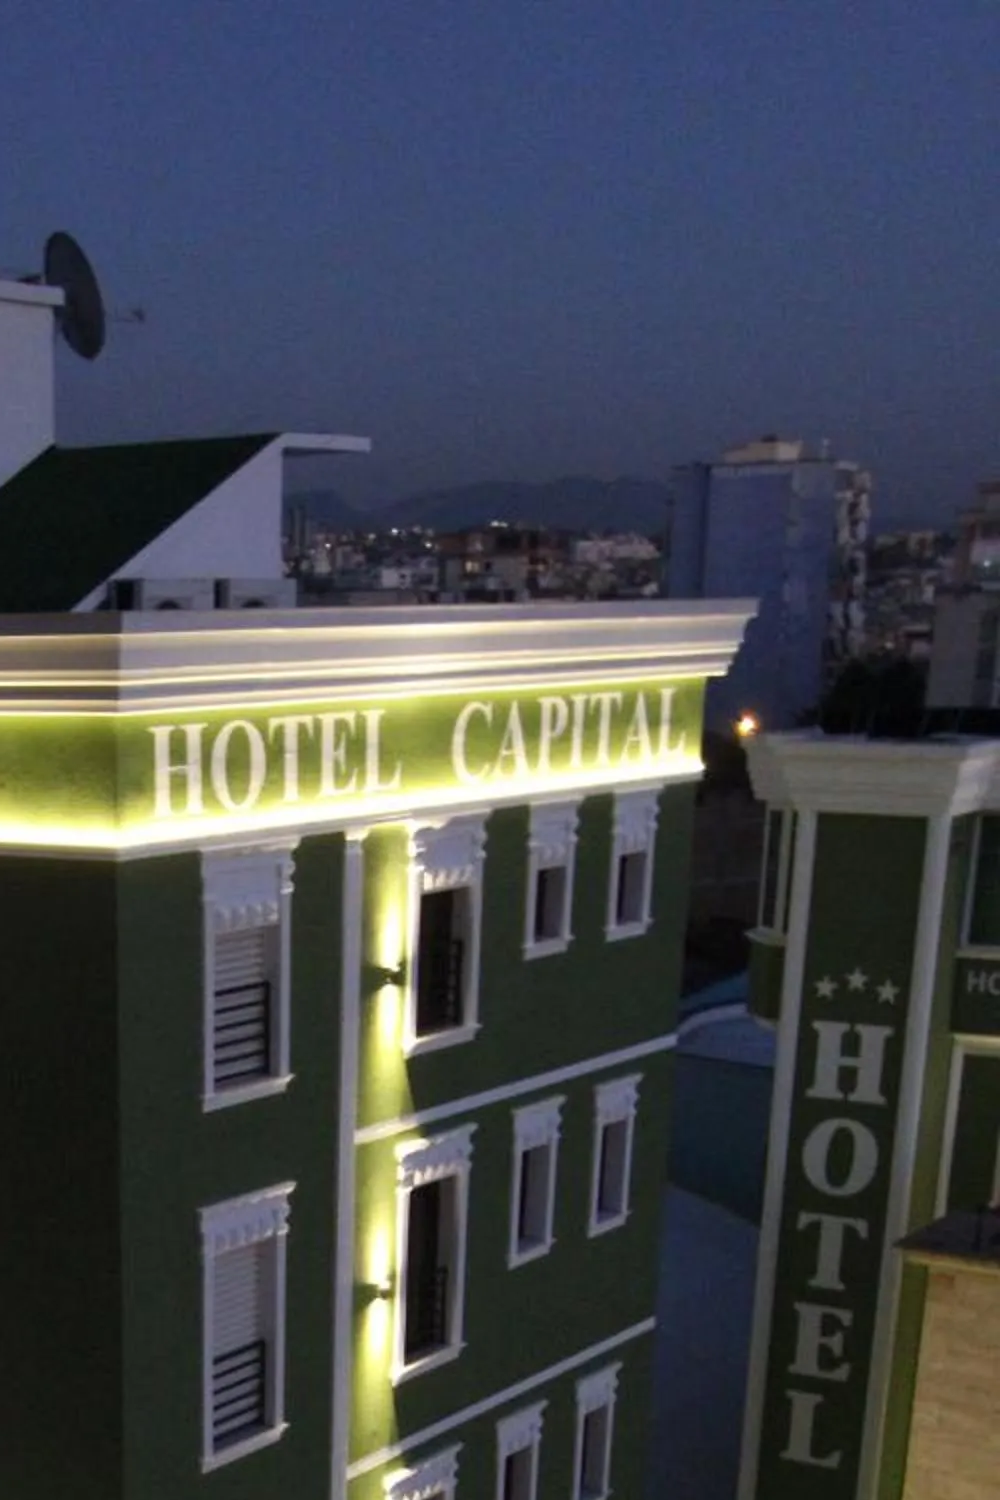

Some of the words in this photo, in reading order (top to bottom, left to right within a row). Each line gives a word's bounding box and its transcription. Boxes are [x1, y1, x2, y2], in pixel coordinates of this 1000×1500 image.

[147, 709, 402, 815] HOTEL
[451, 687, 687, 784] CAPITAL
[779, 1020, 893, 1469] HOTEL
